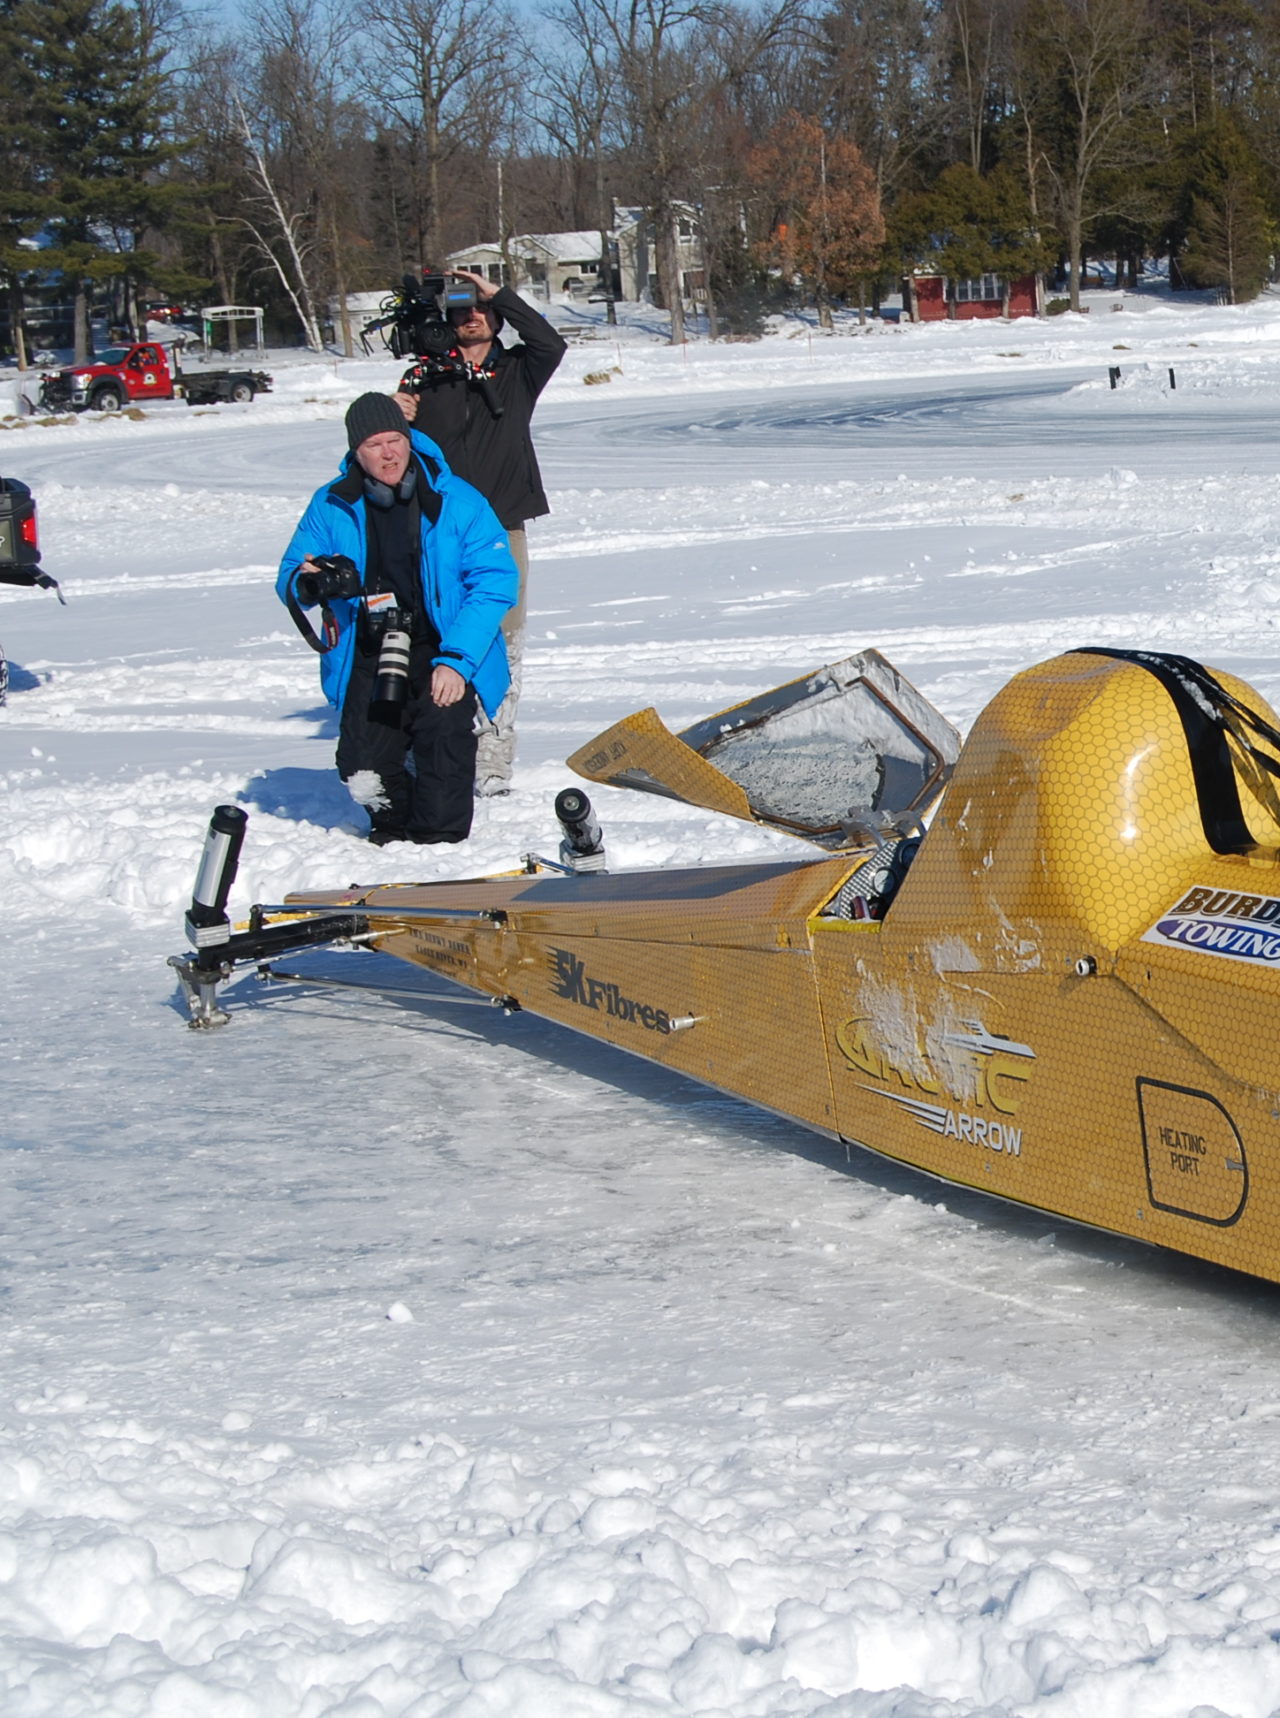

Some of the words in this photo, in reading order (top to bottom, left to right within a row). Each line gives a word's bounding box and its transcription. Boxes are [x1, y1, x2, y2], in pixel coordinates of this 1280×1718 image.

[943, 1110, 1023, 1157] ARROW
[1158, 1126, 1207, 1155] HEATING
[1170, 1151, 1200, 1176] PORT
